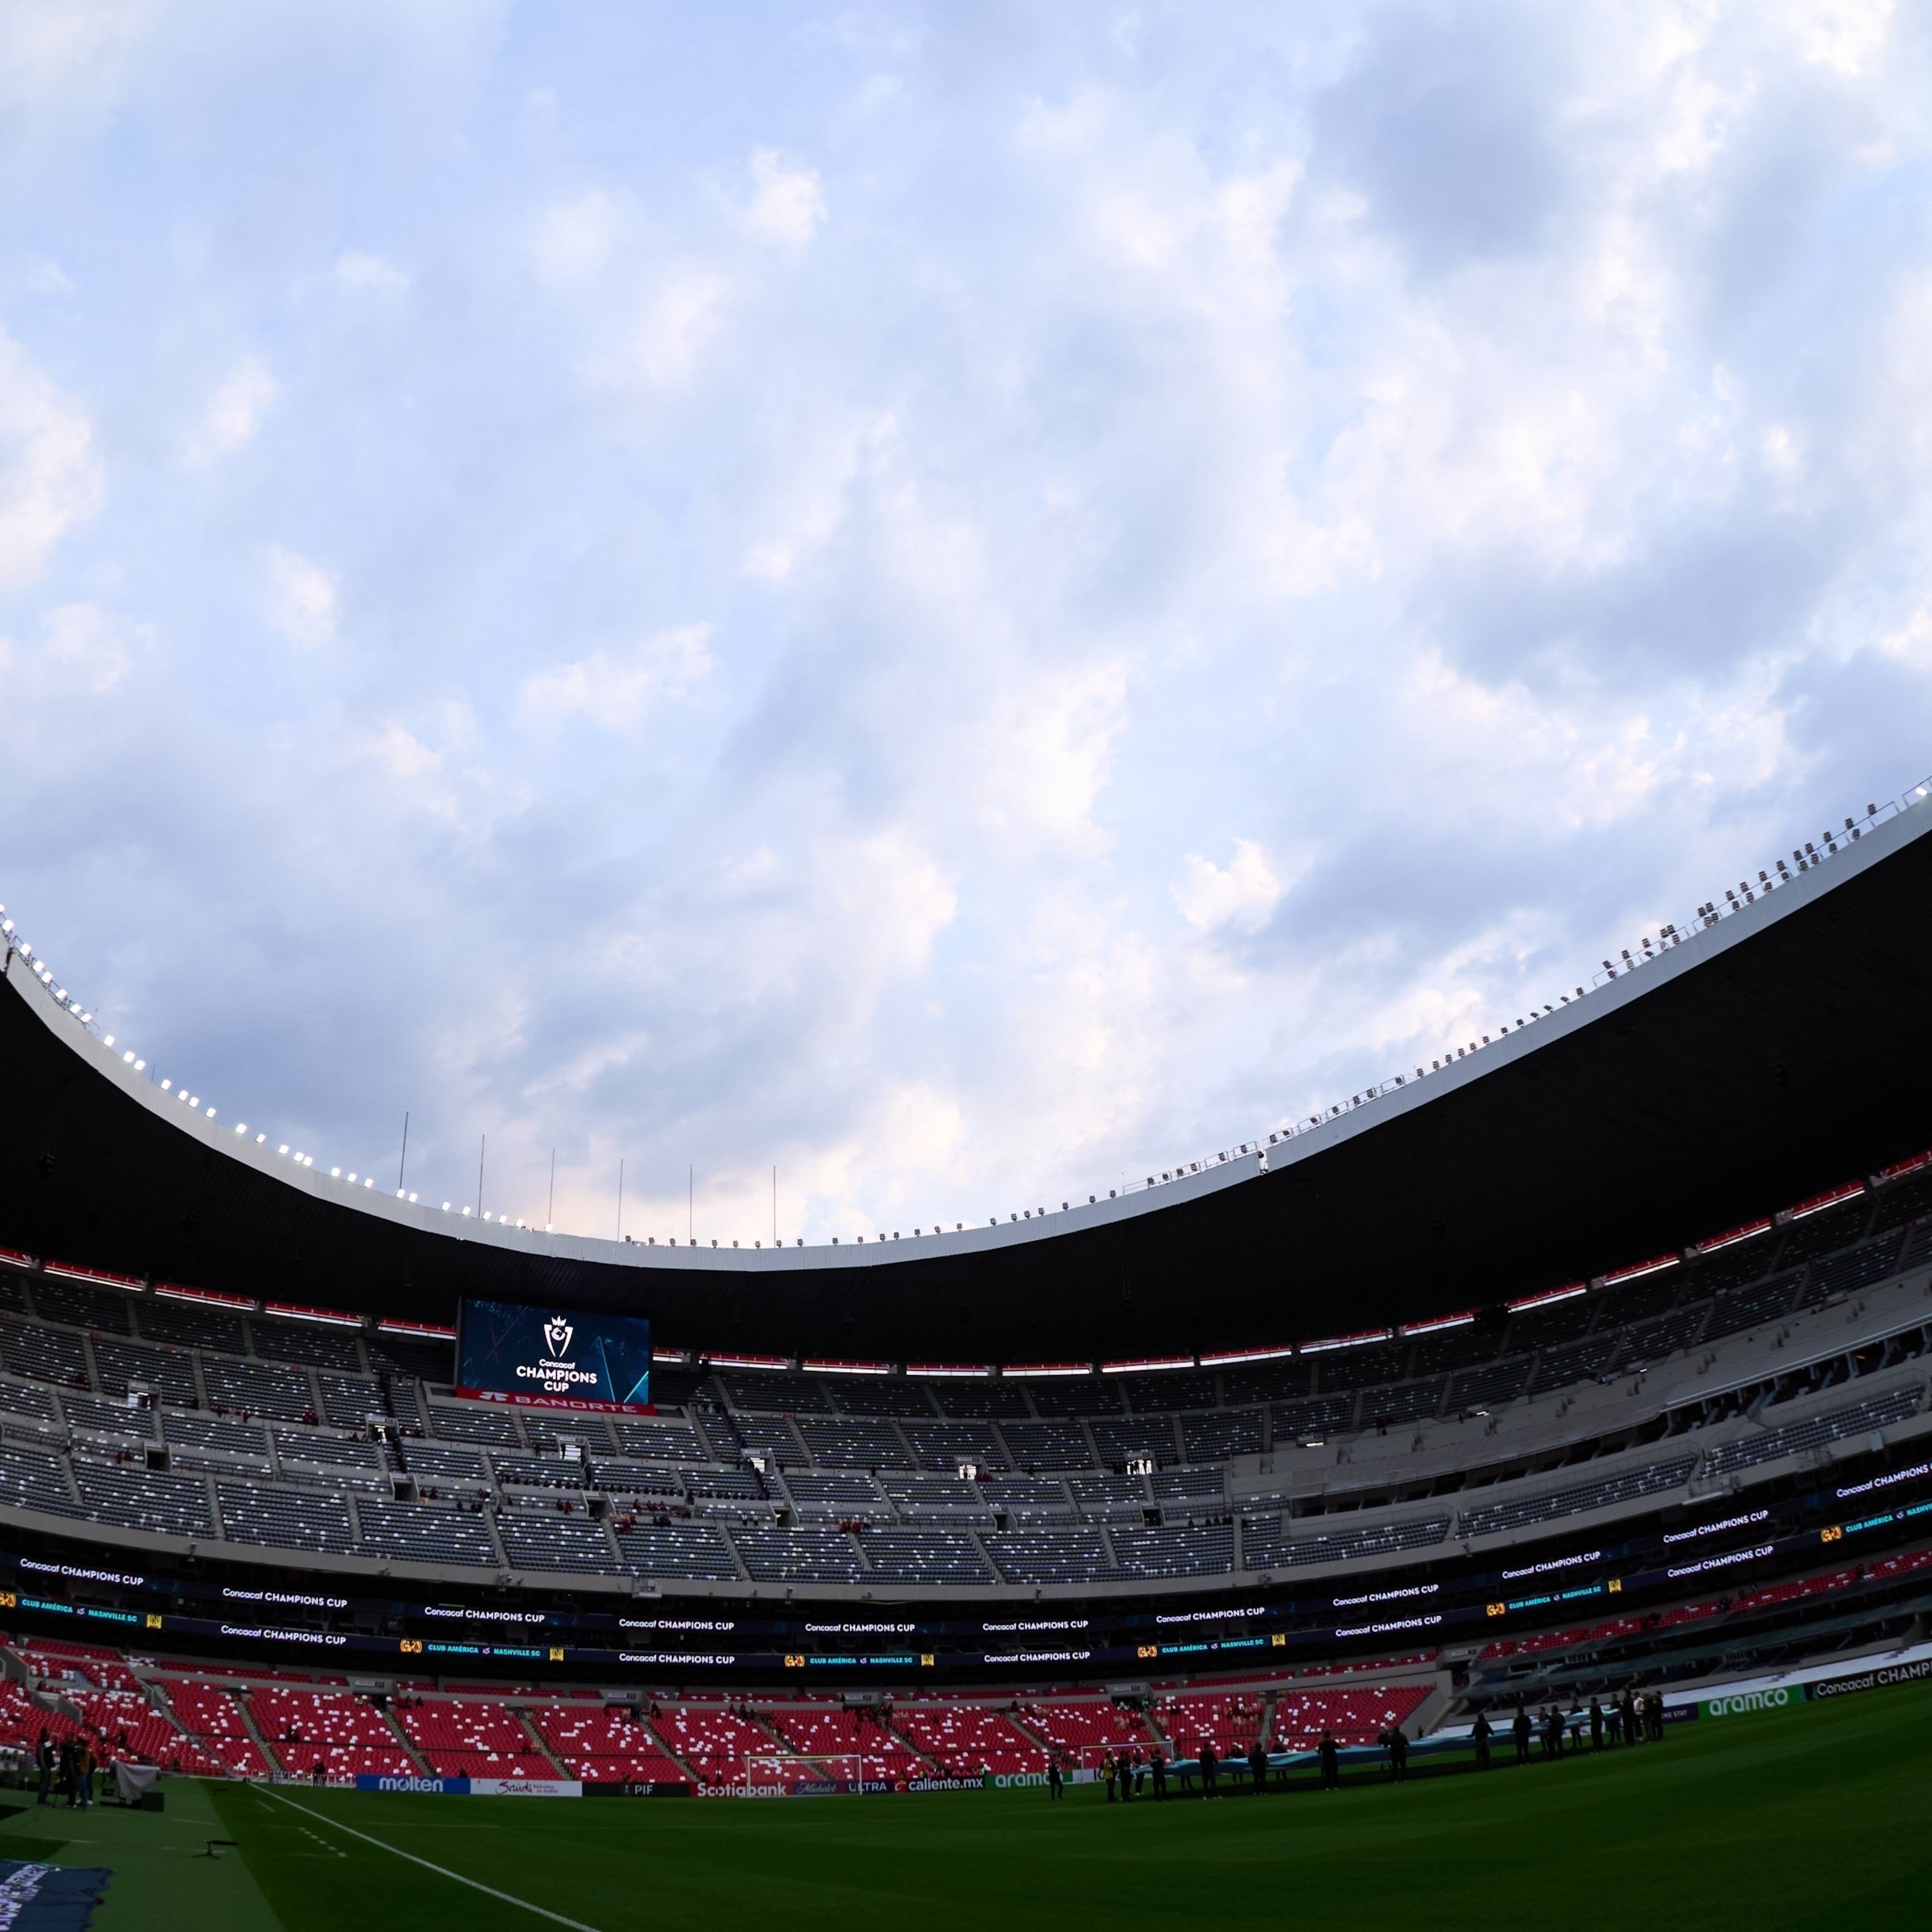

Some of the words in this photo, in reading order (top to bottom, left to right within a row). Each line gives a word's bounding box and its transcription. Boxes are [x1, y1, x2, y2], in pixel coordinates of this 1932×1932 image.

[539, 1359, 575, 1369] Concacaf
[516, 1366, 597, 1384] CHAMPIONS
[544, 1381, 569, 1392] CUP
[515, 1396, 637, 1413] BANORTE
[1837, 1481, 1873, 1497] Concacaf
[1874, 1464, 1929, 1487] CHAMPIONS
[1663, 1529, 1697, 1543] Concacaf
[1698, 1515, 1748, 1534] CHAMPIONS
[1750, 1510, 1768, 1521] CUP
[1846, 1523, 1863, 1532] CLUB
[1863, 1515, 1893, 1528] AMÉRICA
[1502, 1566, 1534, 1578] Concacaf
[1535, 1556, 1582, 1572] CHAMPIONS
[1584, 1551, 1600, 1561] CUP
[1668, 1563, 1701, 1577] Concacaf
[1703, 1550, 1753, 1569] CHAMPIONS
[1755, 1546, 1773, 1556] CUP
[20, 1558, 59, 1572] Concacaf
[61, 1566, 120, 1582] CHAMPIONS
[123, 1576, 143, 1585] CUP
[223, 1588, 263, 1599] Concacaf
[265, 1592, 324, 1605] CHAMPIONS
[327, 1599, 347, 1607] CUP
[1333, 1595, 1367, 1606] Concacaf
[1369, 1587, 1420, 1601] CHAMPIONS
[1421, 1584, 1438, 1593] CUP
[1525, 1597, 1550, 1606] AMÉRICA
[1563, 1588, 1593, 1599] NASHVILLE
[22, 1599, 40, 1607] CLUB
[41, 1603, 73, 1613] AMÉRICA
[88, 1610, 126, 1620] NASHVILLE
[425, 1607, 463, 1617] Concacaf
[466, 1610, 523, 1621] CHAMPIONS
[525, 1614, 545, 1622] CUP
[1156, 1614, 1191, 1623] Concacaf
[1193, 1609, 1245, 1620] CHAMPIONS
[1247, 1607, 1264, 1616] CUP
[619, 1619, 656, 1627] Concacaf
[658, 1620, 713, 1630] CHAMPIONS
[1018, 1621, 1068, 1630] CHAMPIONS
[1335, 1626, 1370, 1636] Concacaf
[1372, 1619, 1422, 1632] CHAMPIONS
[1424, 1616, 1441, 1624] CUP
[221, 1625, 262, 1636] Concacaf
[263, 1629, 323, 1643] CHAMPIONS
[325, 1635, 346, 1644] CUP
[447, 1645, 479, 1653] AMÉRICA
[1221, 1640, 1254, 1648] NASHVILLE
[619, 1653, 656, 1662] Concacaf
[658, 1655, 713, 1663] CHAMPIONS
[1020, 1652, 1070, 1661] CHAMPIONS
[1817, 1676, 1874, 1696] Concacaf
[1709, 1688, 1788, 1716] aramco
[379, 1776, 443, 1791] molten
[496, 1781, 532, 1795] Saudi
[635, 1785, 653, 1794] PIF
[697, 1782, 786, 1797] Scotiabank
[848, 1782, 887, 1792] ULTRA
[909, 1777, 982, 1791] caliente.mx
